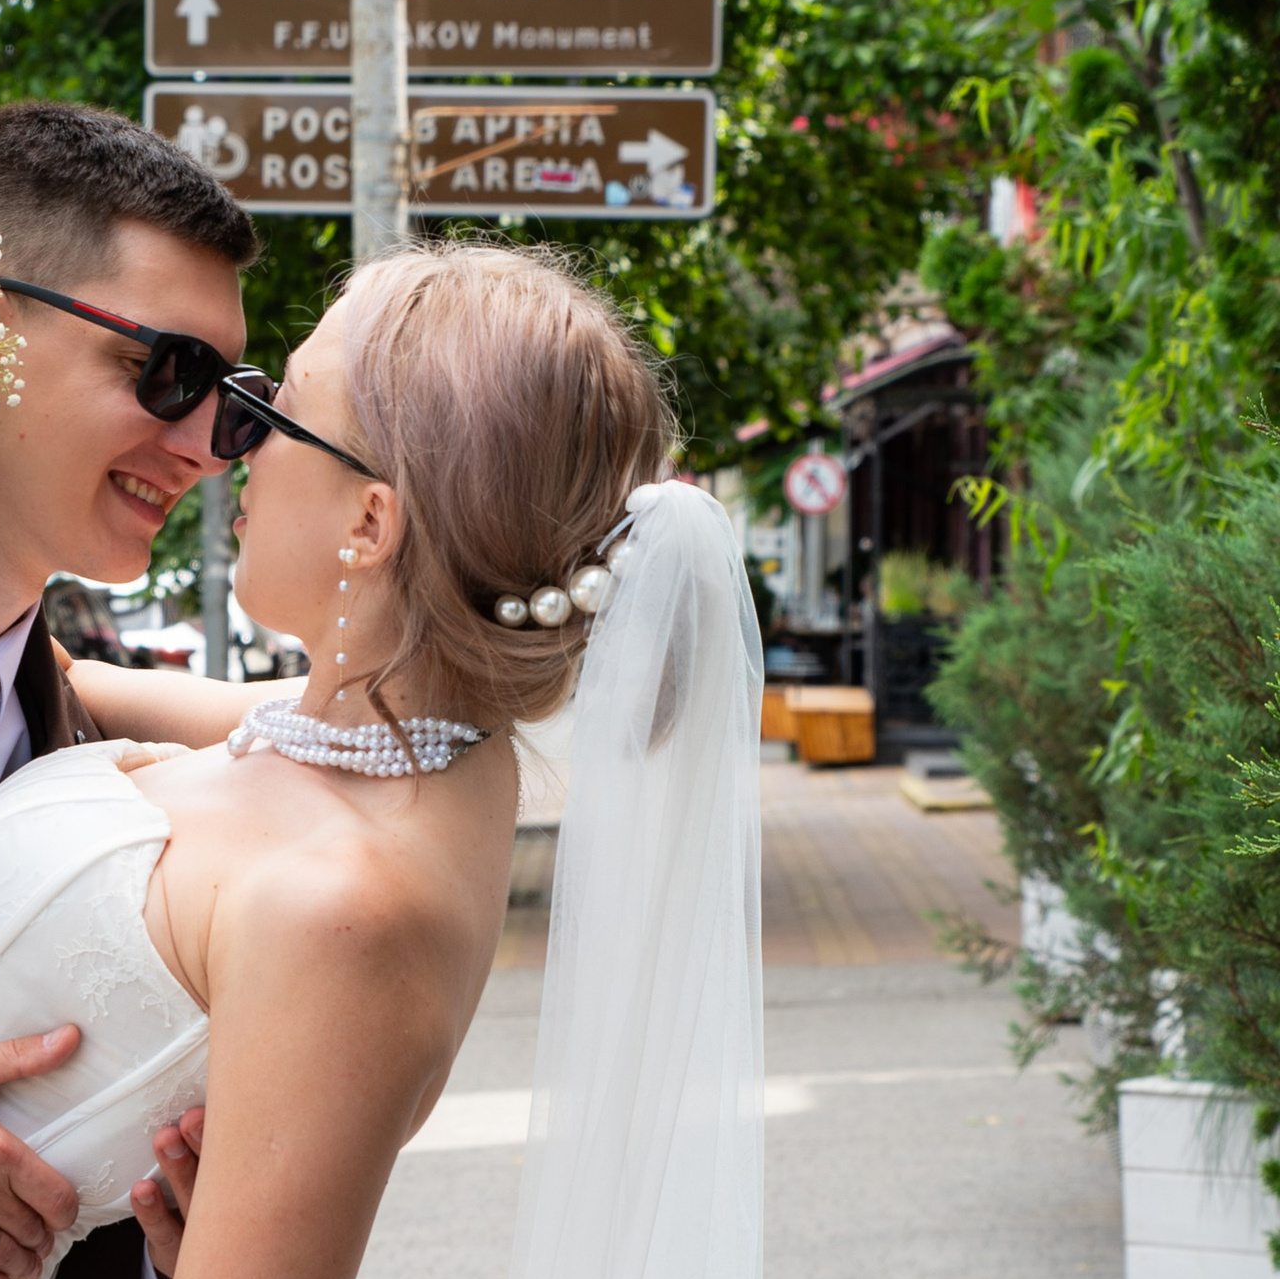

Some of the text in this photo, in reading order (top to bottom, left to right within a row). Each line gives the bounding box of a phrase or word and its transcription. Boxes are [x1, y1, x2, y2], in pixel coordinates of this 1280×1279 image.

[492, 21, 653, 50] Monument
[262, 105, 438, 144] РОСВ
[261, 152, 437, 191] ROSV
